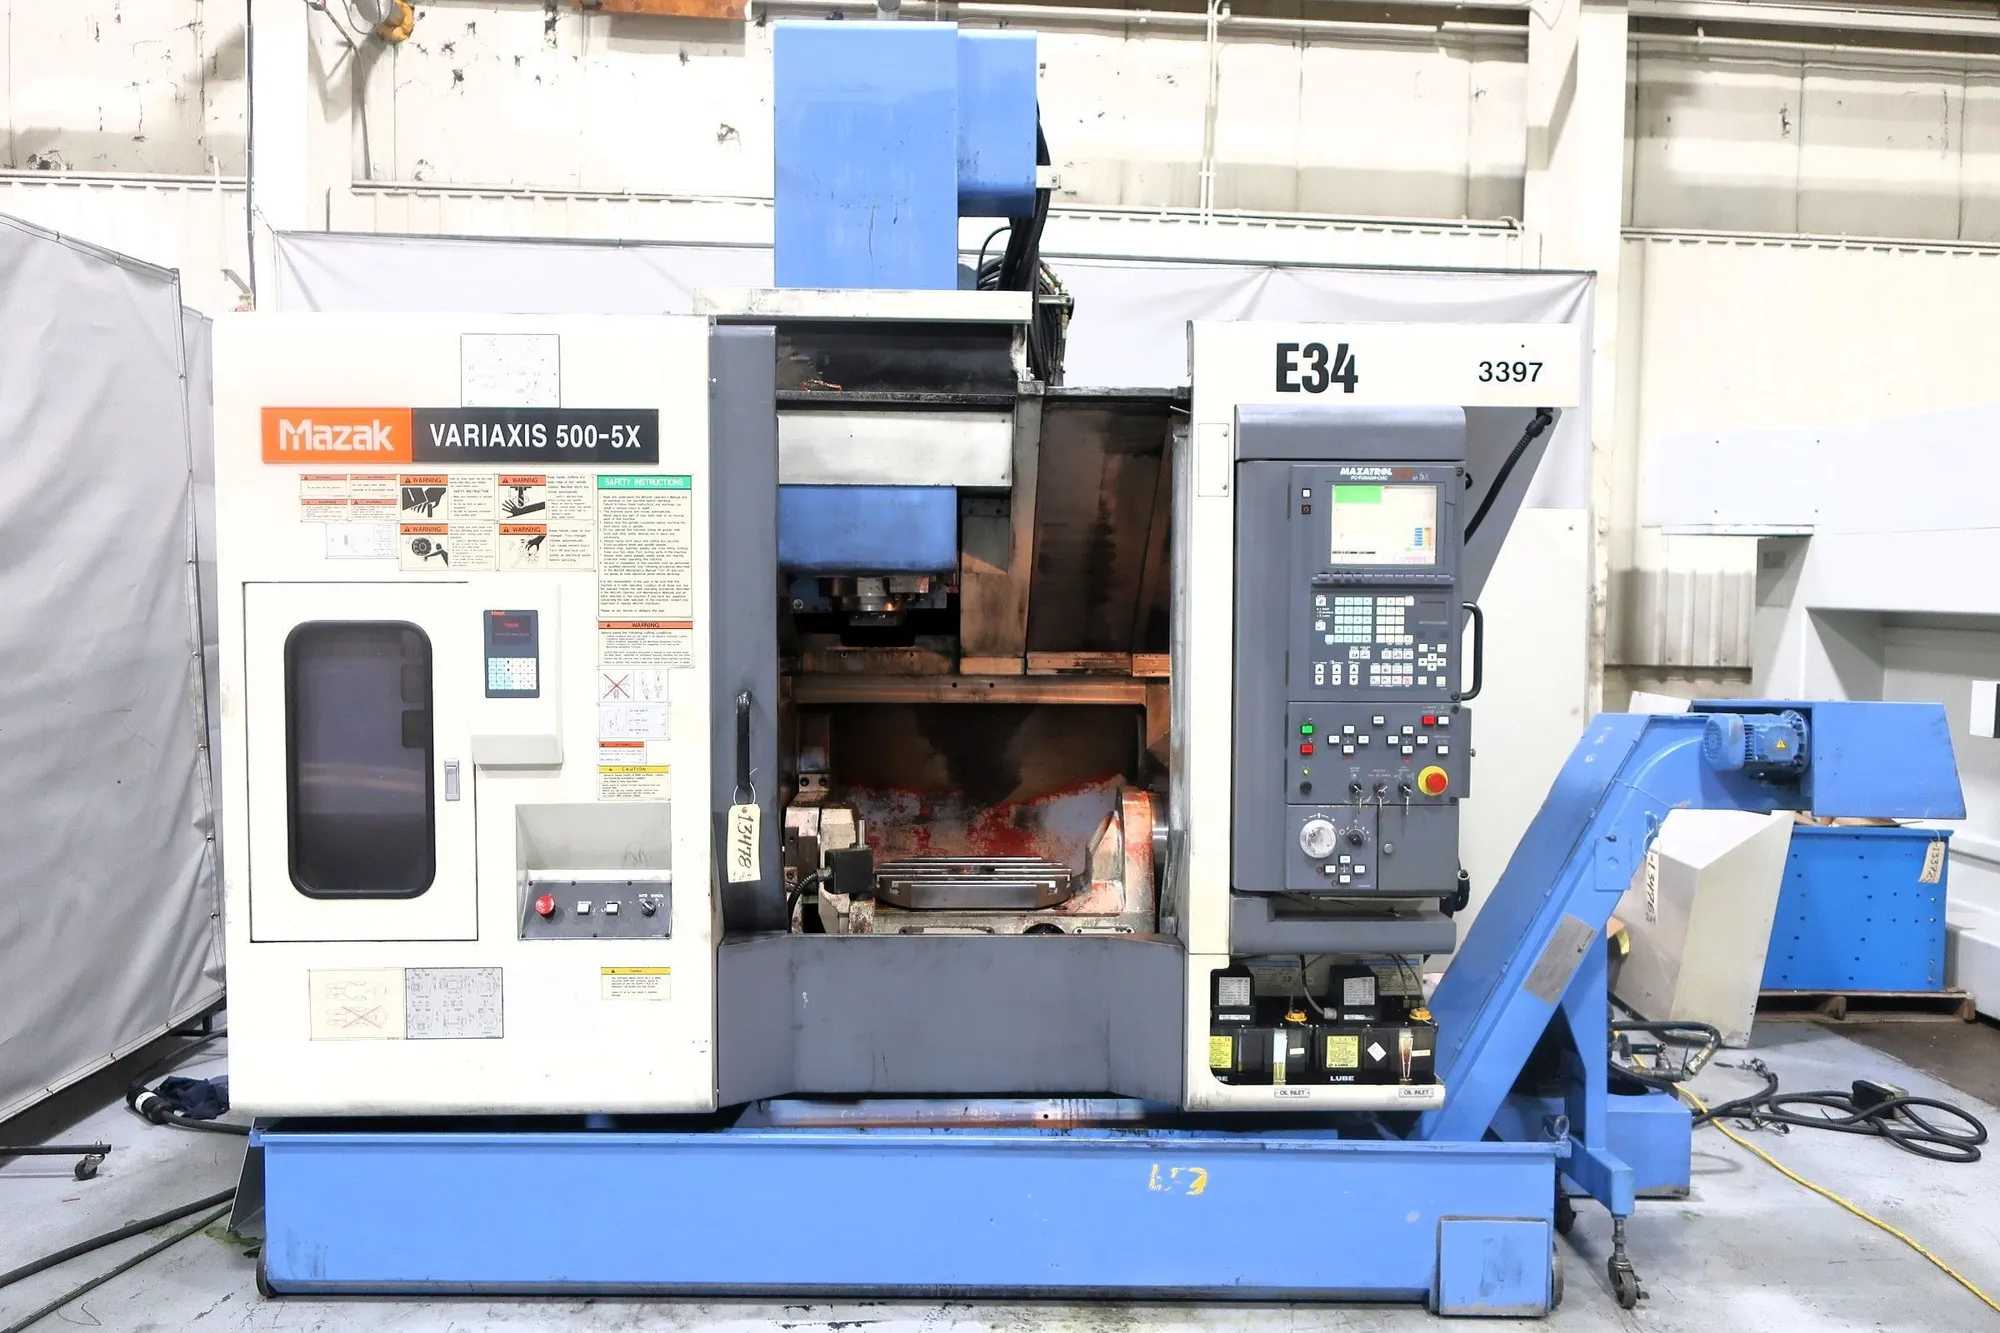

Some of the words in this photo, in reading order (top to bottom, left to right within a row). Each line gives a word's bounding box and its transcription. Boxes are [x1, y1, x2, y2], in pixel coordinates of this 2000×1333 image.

[1275, 342, 1359, 394] E34
[1477, 360, 1544, 383] 3397
[278, 418, 395, 452] Mazak
[430, 423, 547, 448] VARIAXIS
[556, 424, 642, 449] 500-5X
[606, 478, 630, 487] SAFETY
[1340, 467, 1392, 475] MAZATROL
[737, 814, 754, 869] 13478
